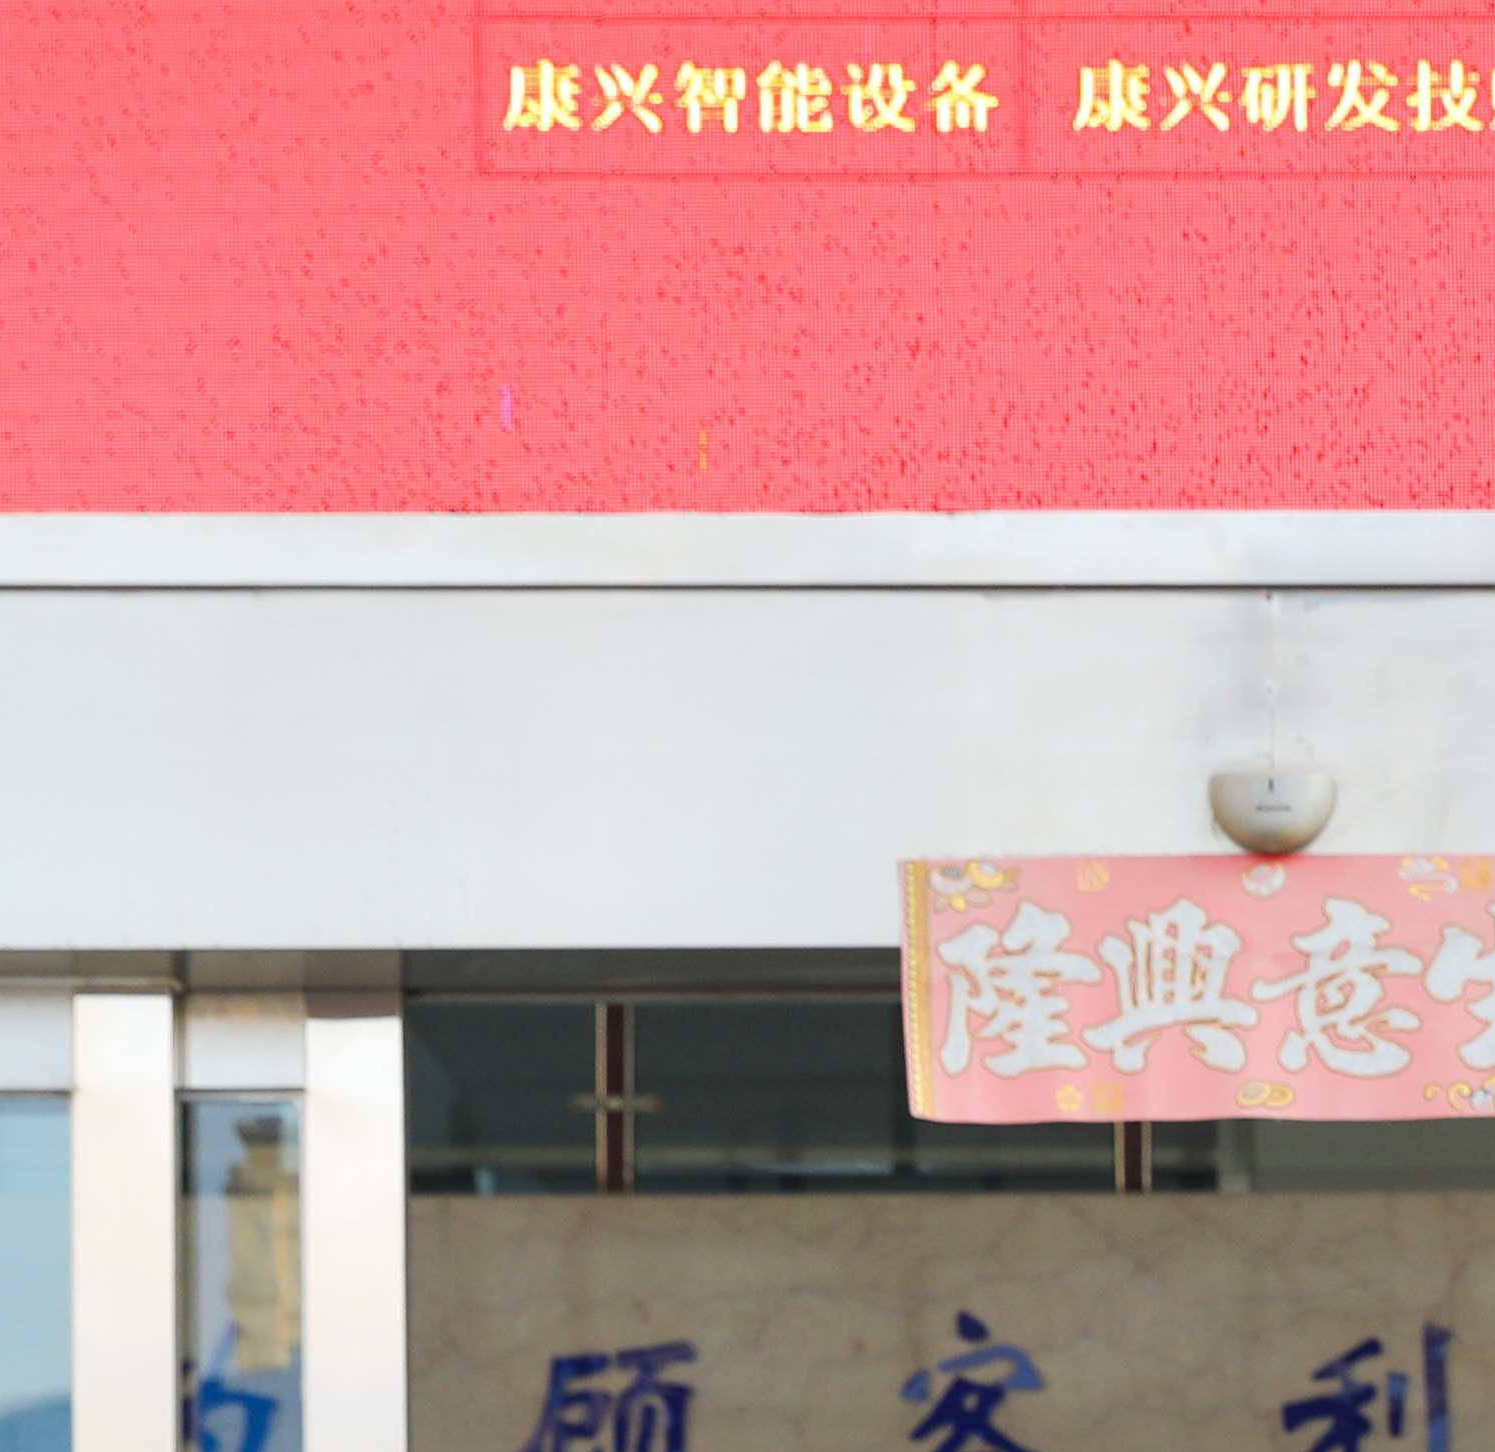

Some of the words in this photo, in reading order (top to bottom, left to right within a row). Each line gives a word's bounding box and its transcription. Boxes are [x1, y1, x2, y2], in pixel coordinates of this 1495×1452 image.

[504, 60, 998, 133] 康兴智能设备
